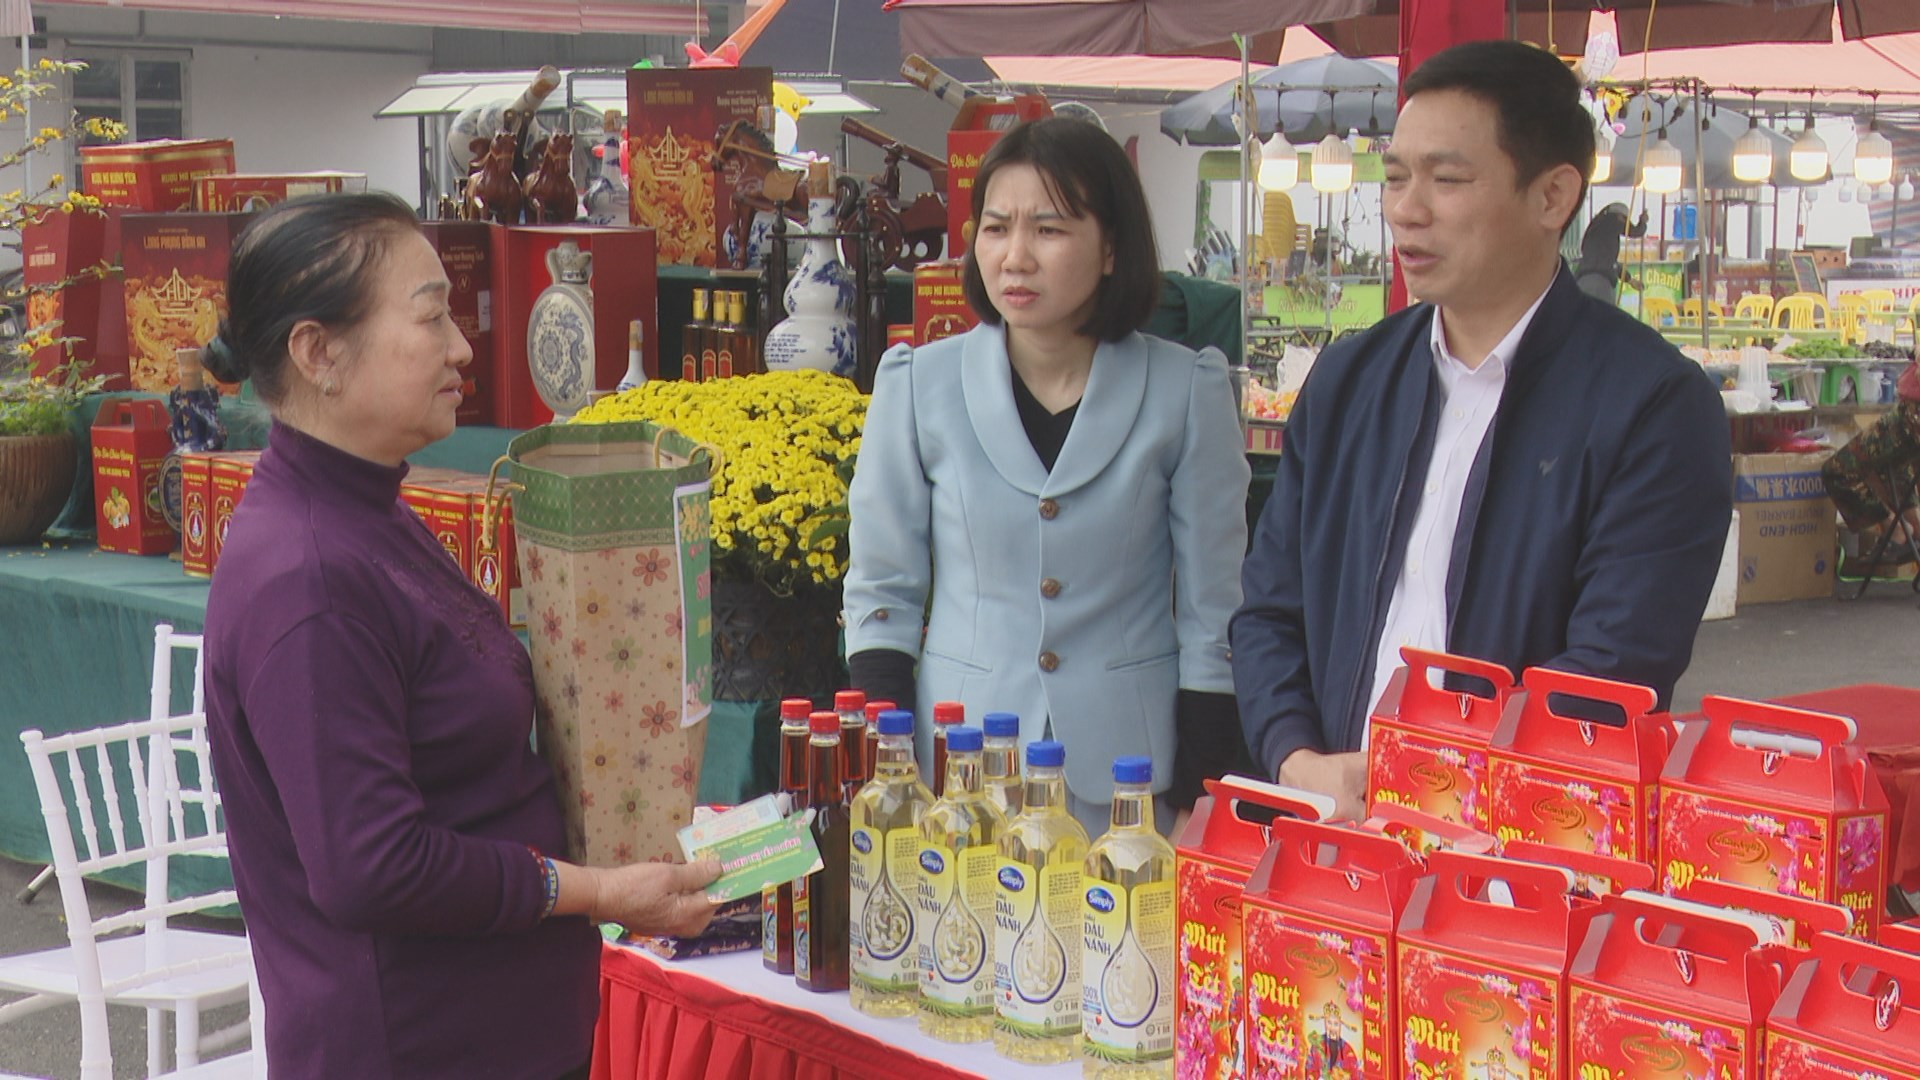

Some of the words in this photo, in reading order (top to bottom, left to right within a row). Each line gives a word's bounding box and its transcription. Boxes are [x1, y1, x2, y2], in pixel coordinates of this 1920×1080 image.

[1646, 268, 1681, 291] Chanh
[1760, 523, 1817, 537] HIGH-END
[1000, 873, 1024, 889] Simply
[1088, 891, 1114, 912] Simply
[1188, 960, 1220, 995] Tết
[1258, 1014, 1295, 1049] Tết
